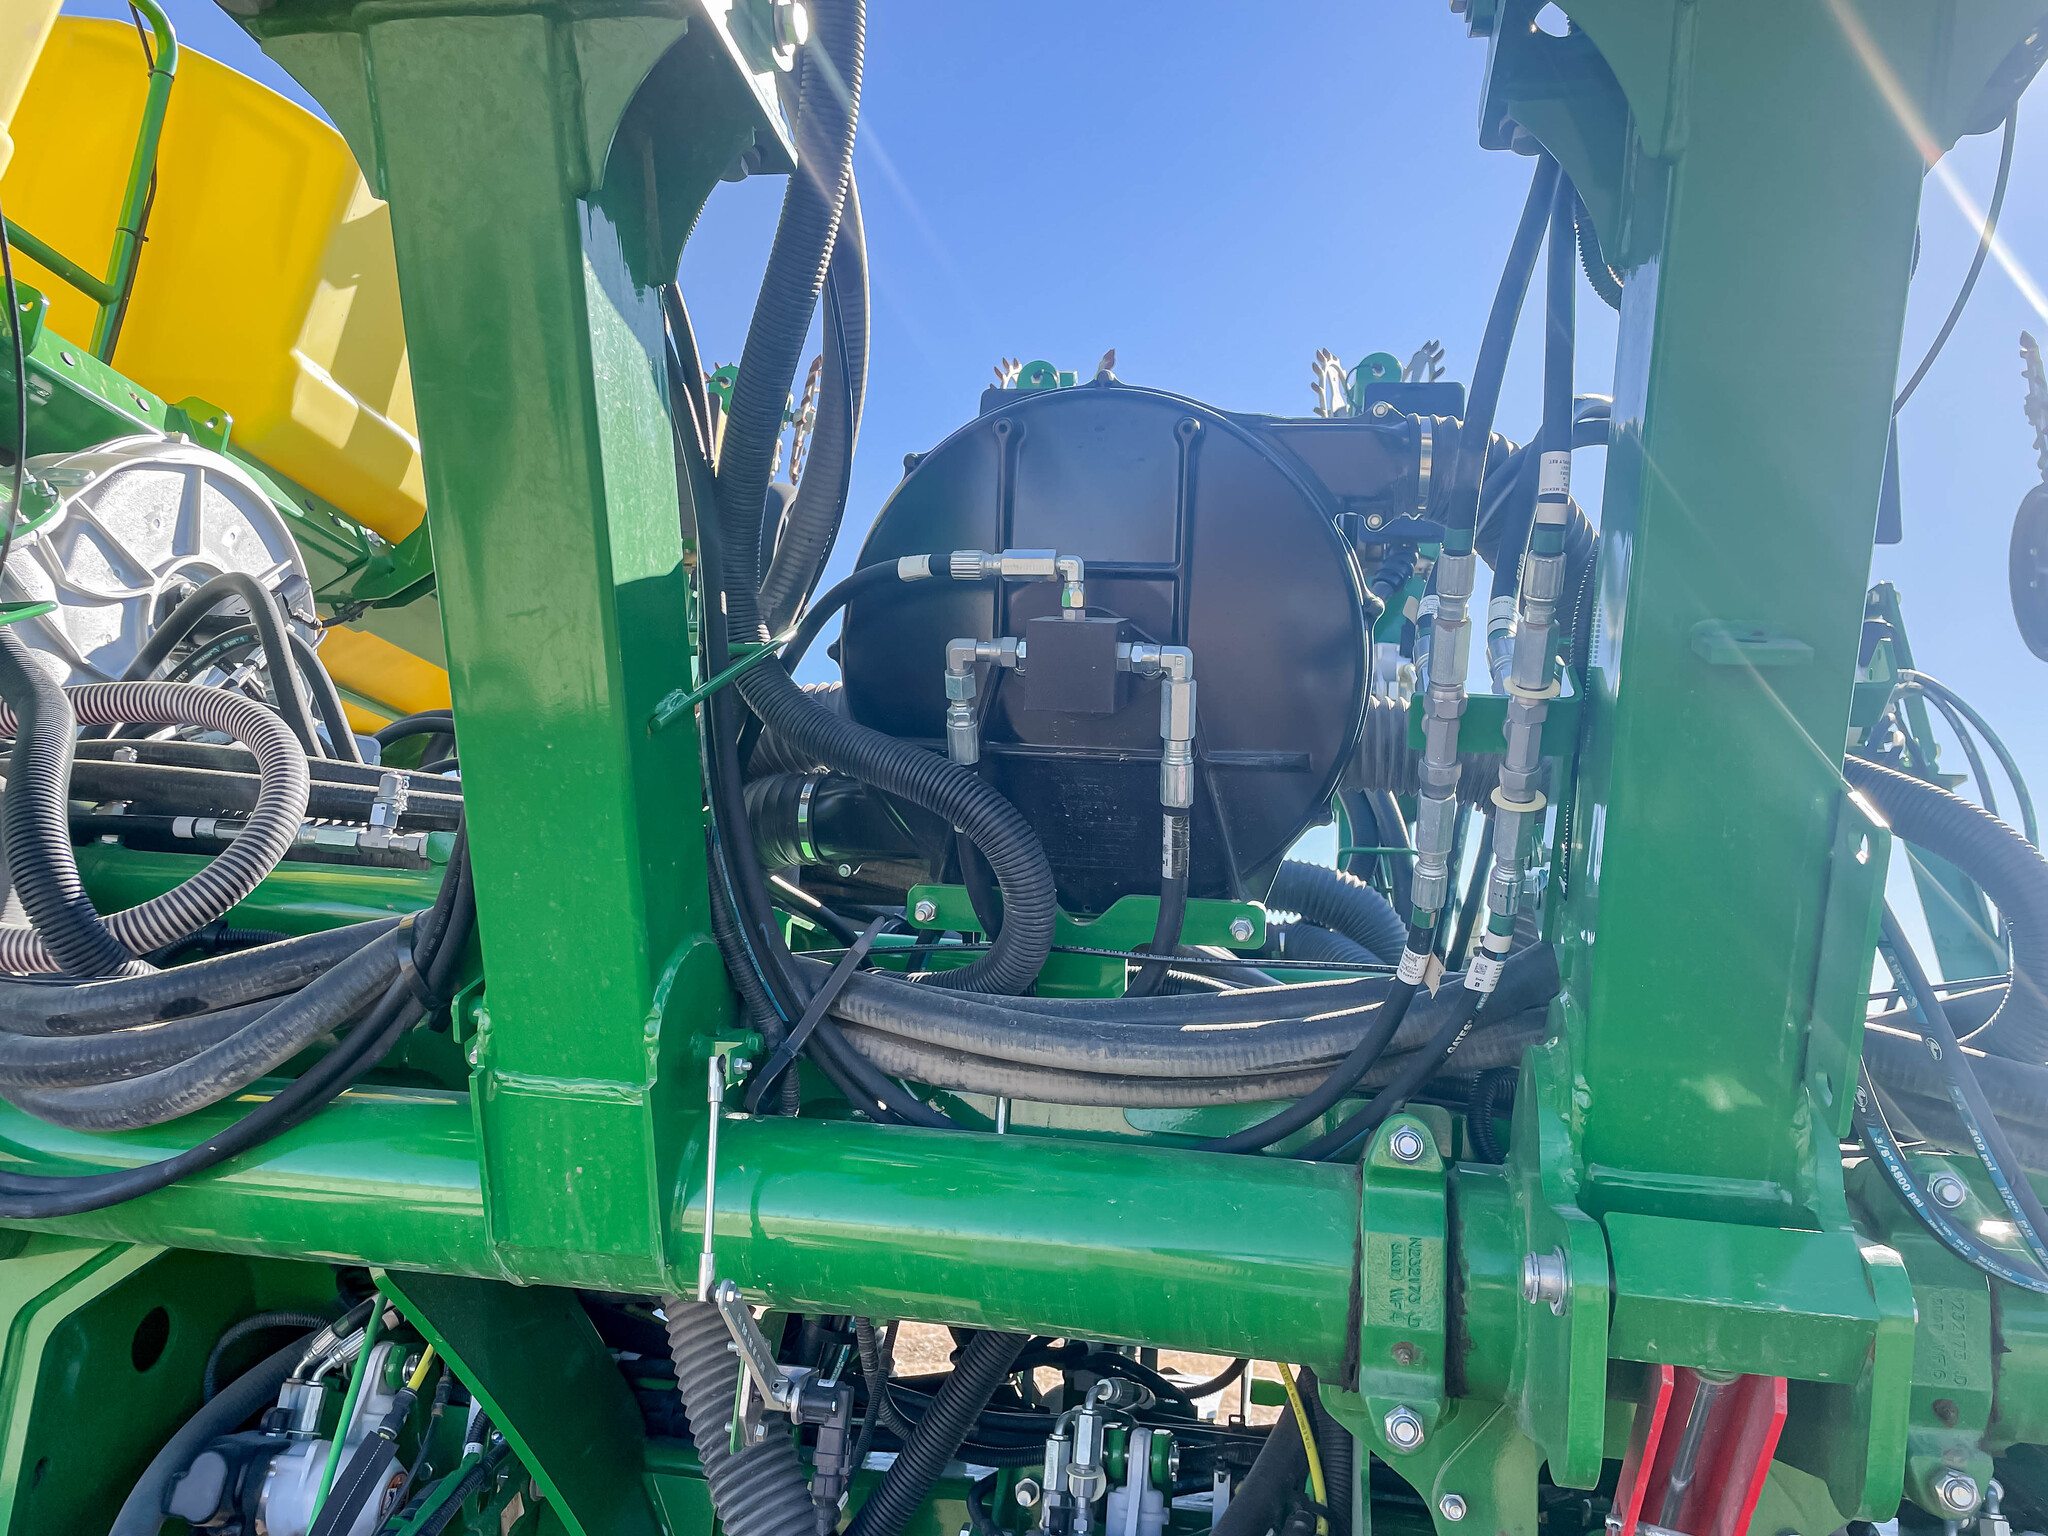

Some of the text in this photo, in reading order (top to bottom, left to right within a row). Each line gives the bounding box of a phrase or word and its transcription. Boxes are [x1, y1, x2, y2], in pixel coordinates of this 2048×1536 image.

[1446, 1022, 1473, 1053] GATES
[1980, 1154, 1997, 1171] psi
[1891, 1166, 1911, 1191] 4800
[1907, 1192, 1925, 1208] psi
